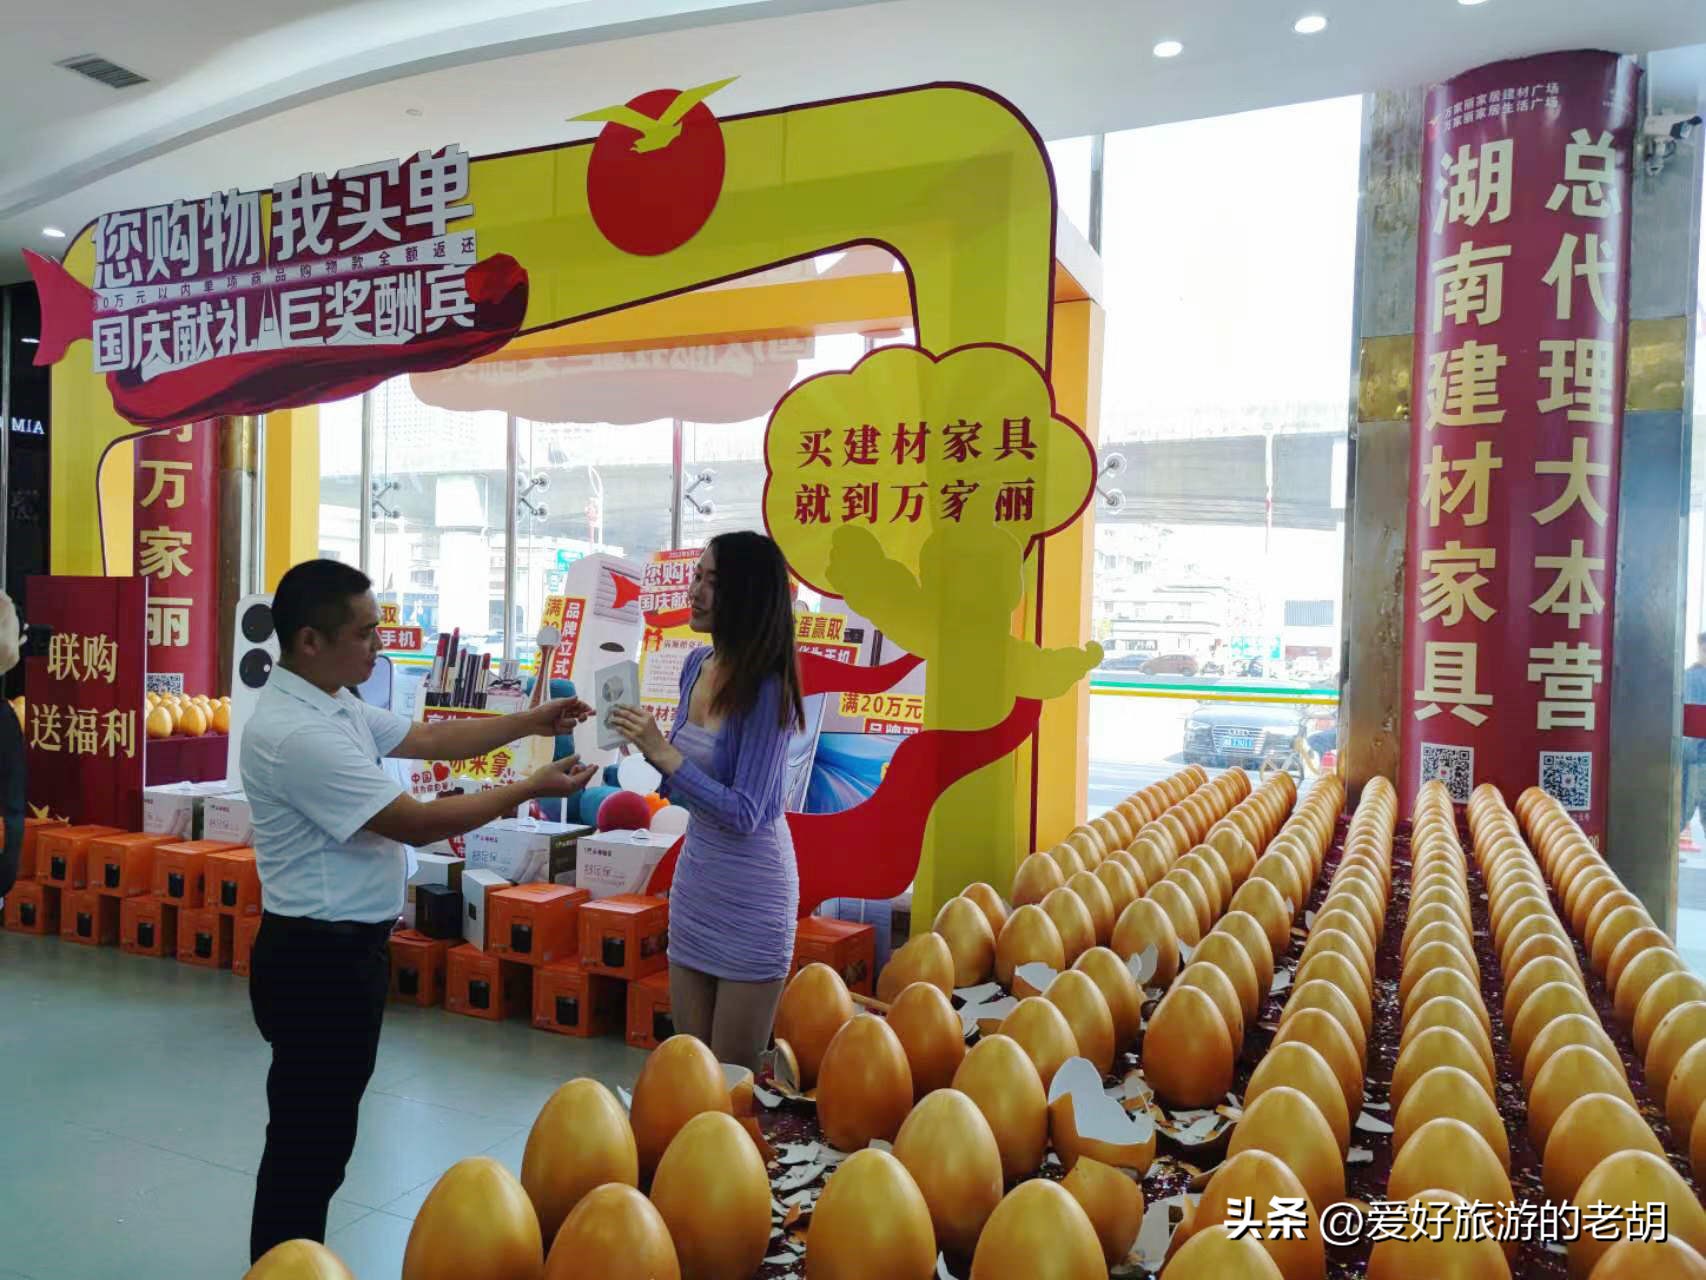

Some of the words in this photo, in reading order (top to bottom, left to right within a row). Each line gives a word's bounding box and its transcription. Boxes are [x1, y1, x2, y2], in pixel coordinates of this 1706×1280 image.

[797, 416, 1038, 468] 买建材家具
[1414, 138, 1514, 728] 湖南建材家具
[1528, 127, 1622, 731] 总代理大本营
[794, 477, 1035, 524] 就到万家丽
[48, 632, 118, 684] 联购
[30, 704, 136, 758] 送福利
[841, 692, 923, 719] 满20万元
